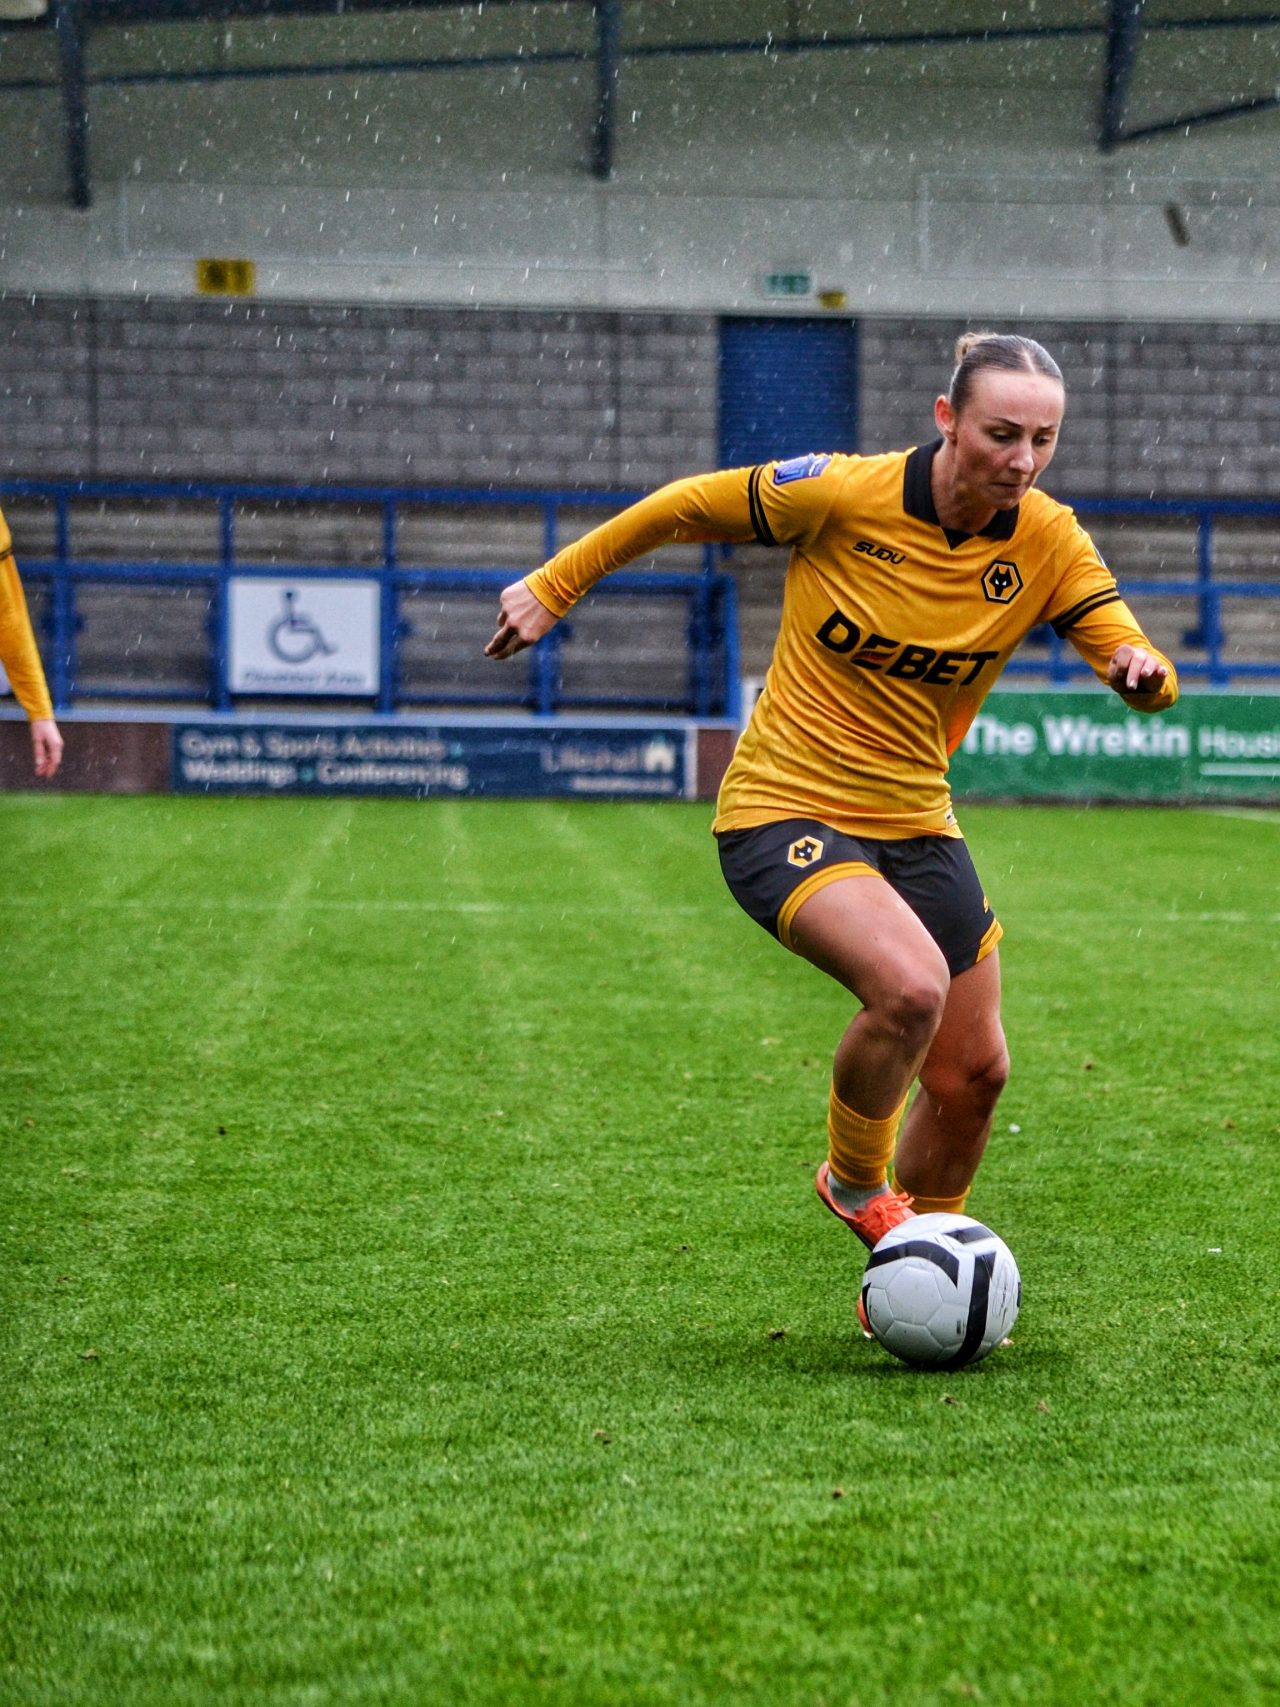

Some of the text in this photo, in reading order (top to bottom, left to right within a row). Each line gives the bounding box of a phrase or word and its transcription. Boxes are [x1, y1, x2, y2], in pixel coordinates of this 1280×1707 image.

[852, 541, 907, 565] SUDU
[816, 610, 999, 686] DEBET
[964, 714, 1192, 758] The Wrekin
[182, 760, 297, 788] Weddings
